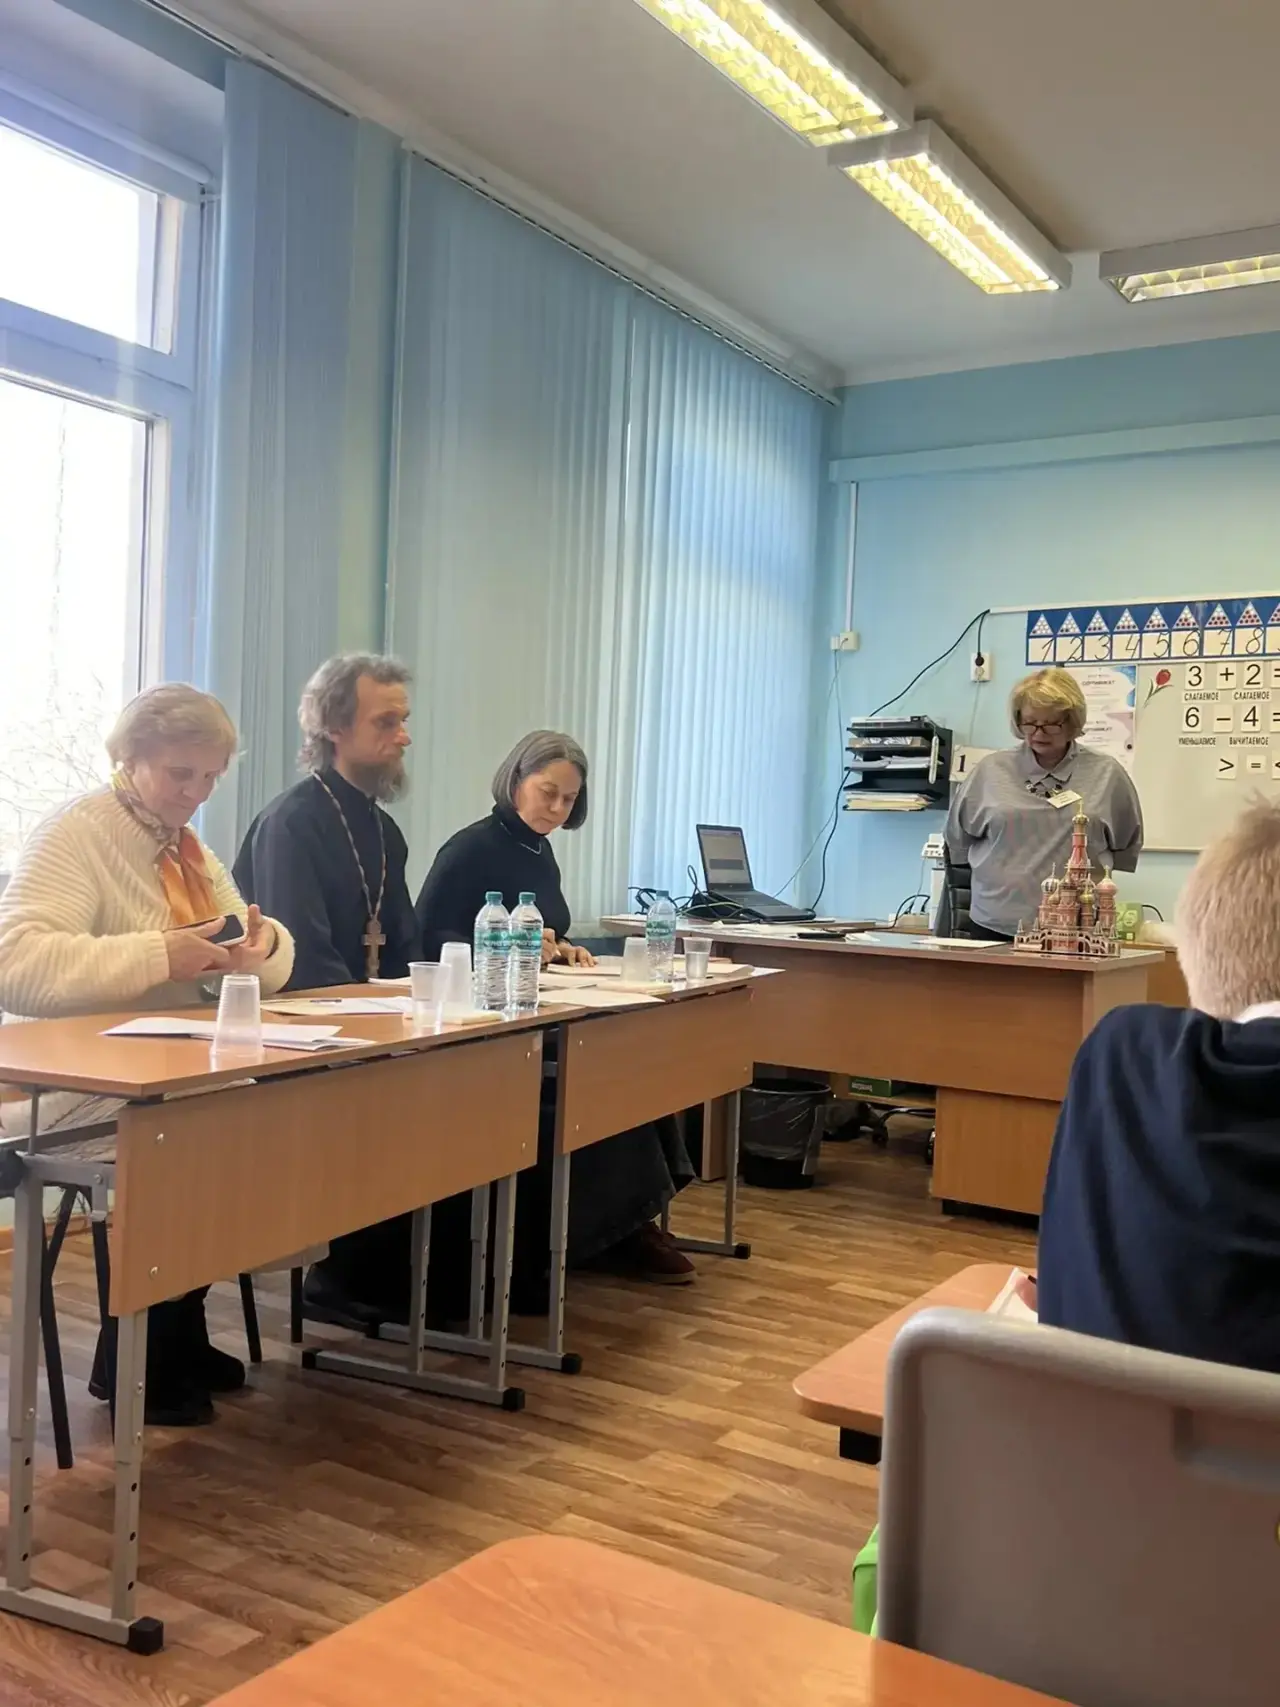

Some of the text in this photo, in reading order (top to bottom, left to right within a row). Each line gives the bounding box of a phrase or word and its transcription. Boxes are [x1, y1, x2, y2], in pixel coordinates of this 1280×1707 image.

[1041, 627, 1264, 662] 1 2 3 4 5 6 7 8
[1188, 665, 1202, 687] 3
[1245, 664, 1261, 685] 2
[1184, 692, 1219, 701] СЛАГАЕМОЕ
[1233, 691, 1270, 700] СЛАГАЕМОЕ
[1185, 706, 1200, 728] 6
[1243, 705, 1259, 727] 4
[1178, 737, 1216, 746] УМЕНЬШАЕМОЕ
[1229, 736, 1269, 745] ВЫЧИТАЕМОЕ
